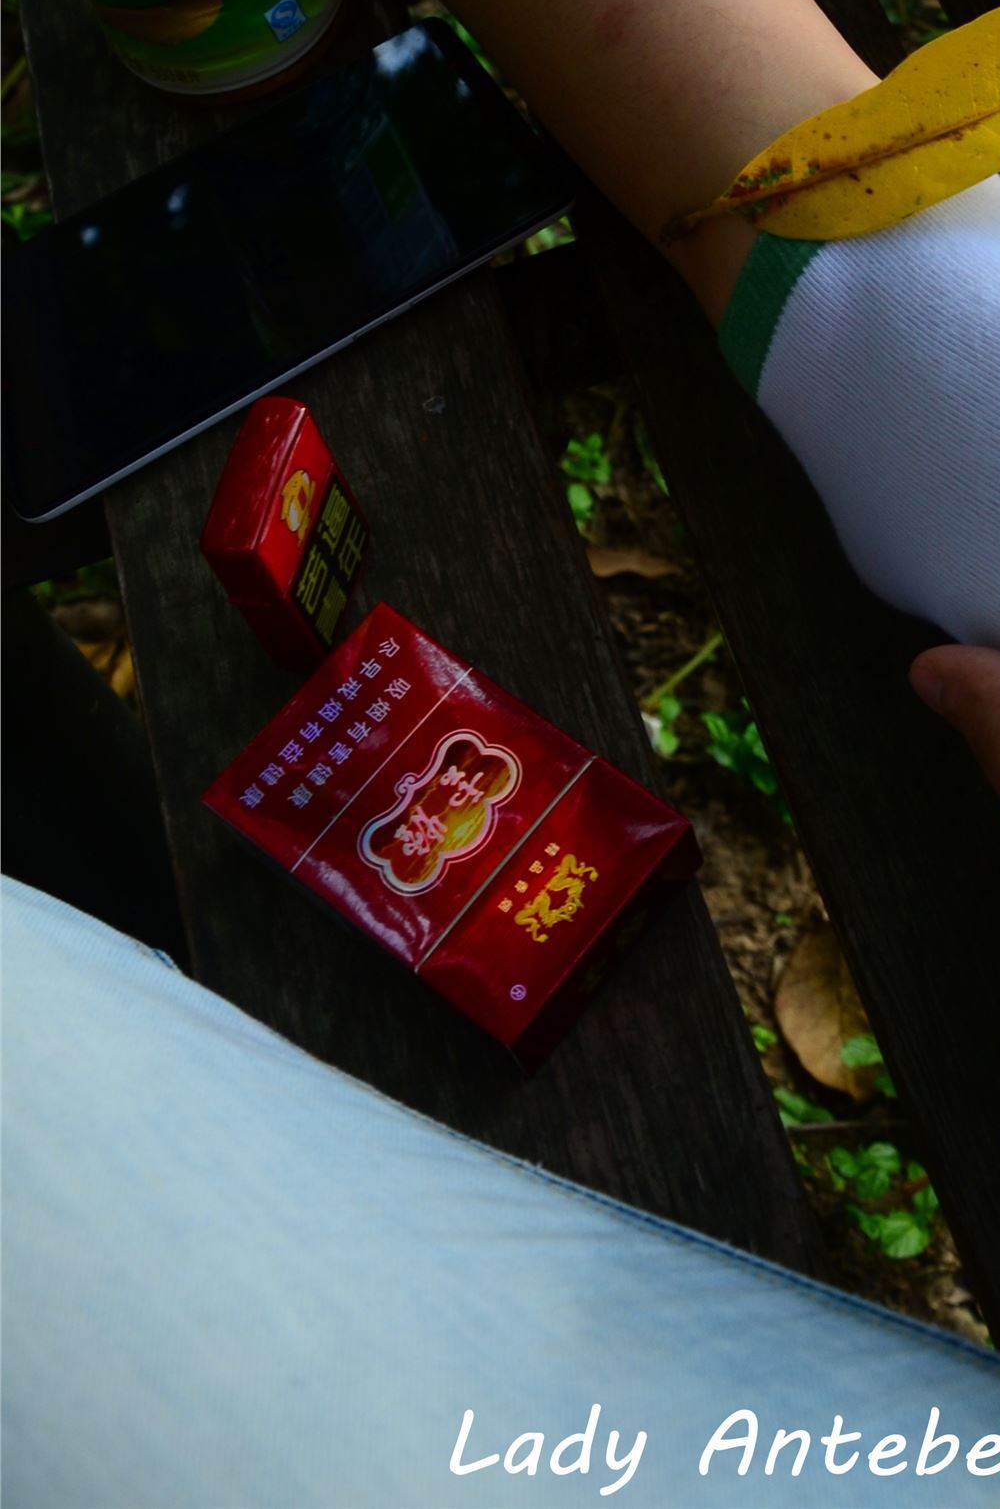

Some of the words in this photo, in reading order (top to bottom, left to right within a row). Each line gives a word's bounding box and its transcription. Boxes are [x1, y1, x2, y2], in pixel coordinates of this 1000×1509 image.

[237, 638, 400, 810] 尽早戒烟有益健康
[285, 675, 411, 810] 吸烟有害健康
[495, 840, 561, 913] 精品香烟
